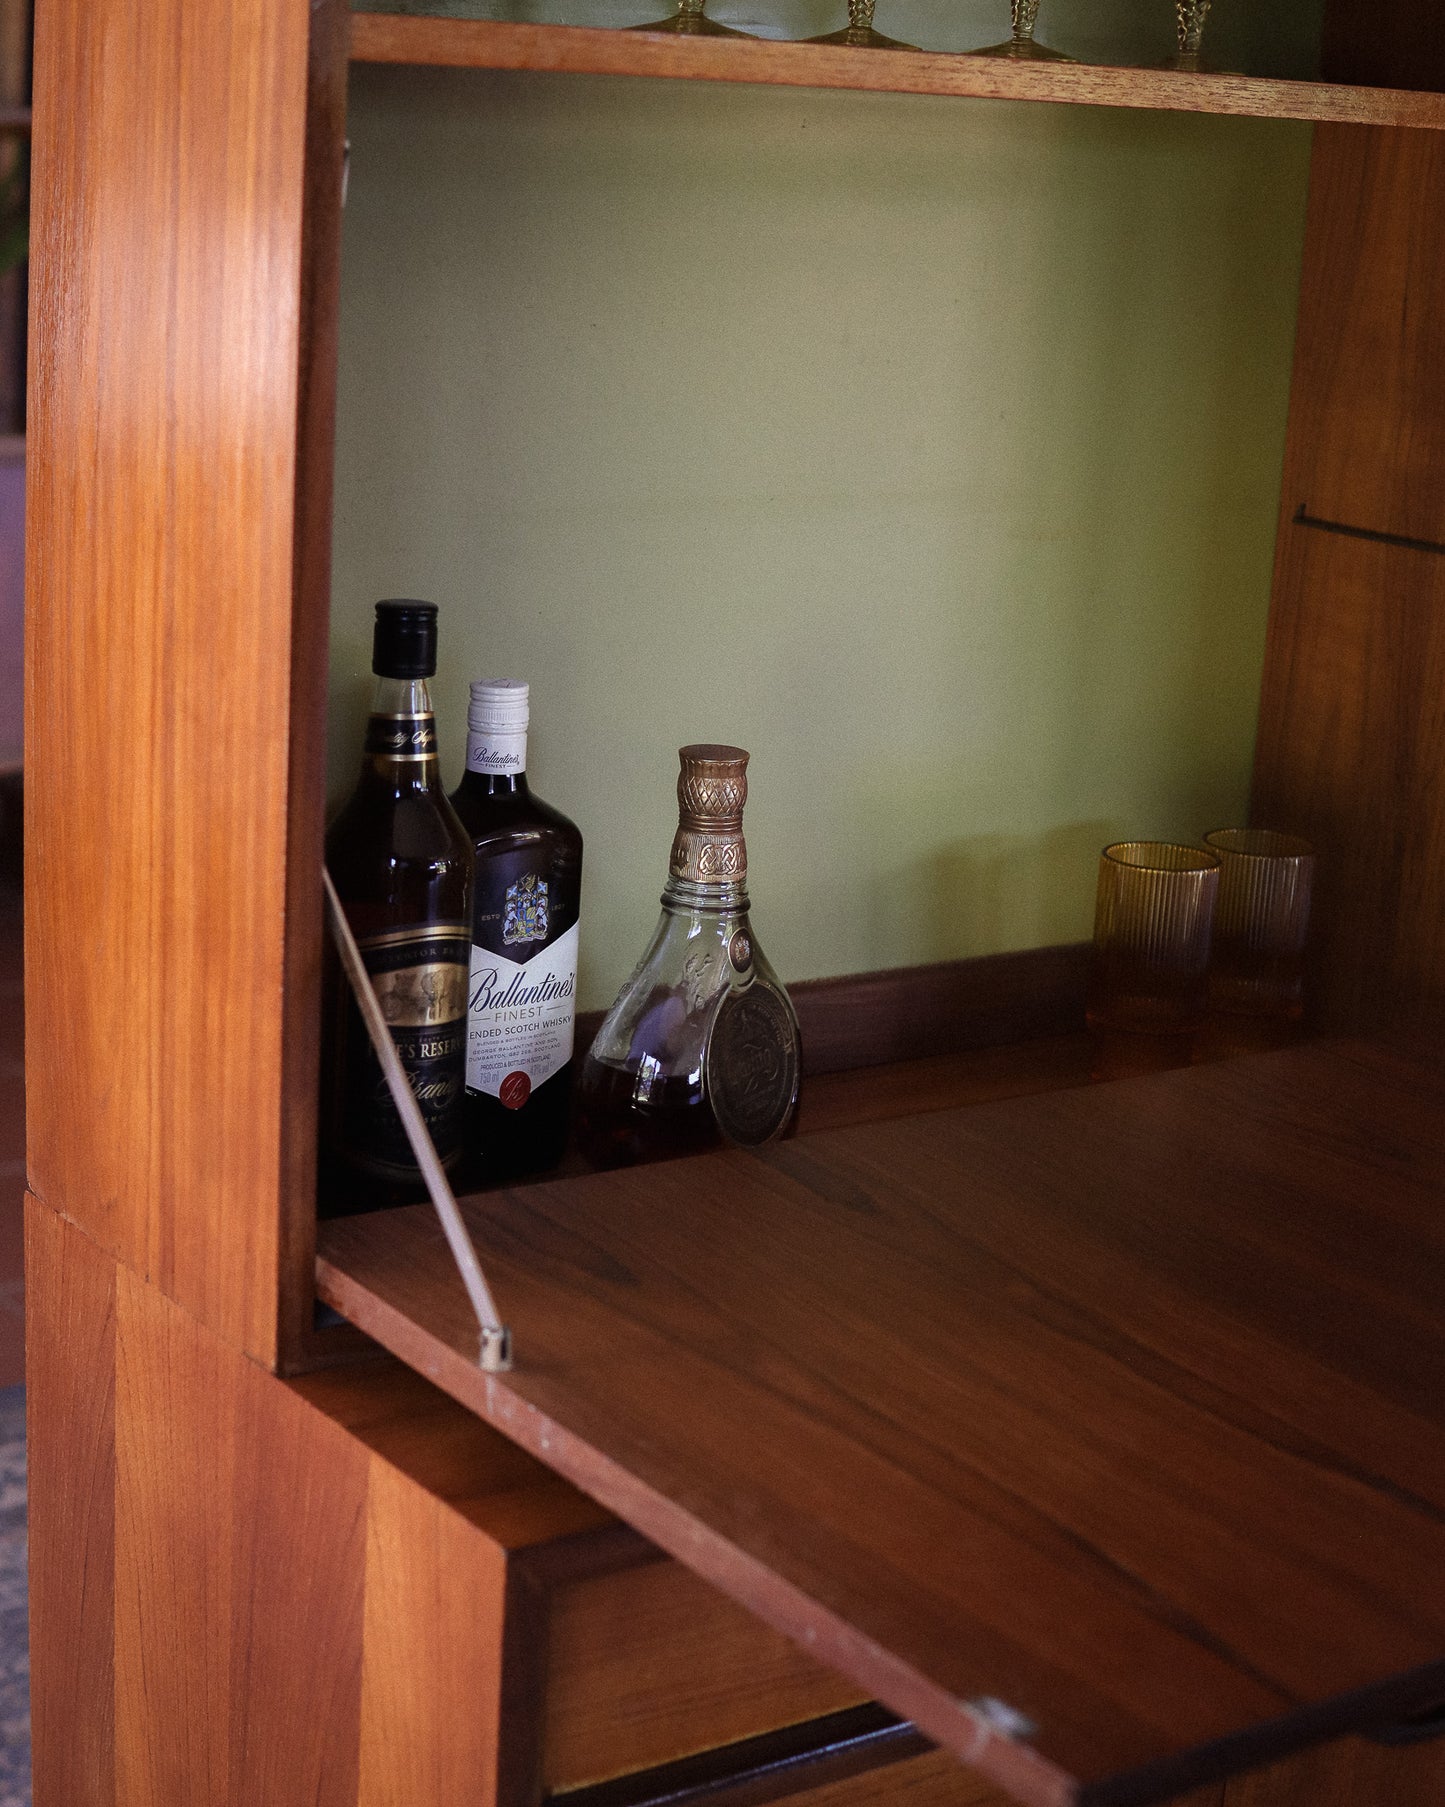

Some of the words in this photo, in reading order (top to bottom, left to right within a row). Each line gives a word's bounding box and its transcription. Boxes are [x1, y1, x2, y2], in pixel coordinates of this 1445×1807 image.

[473, 746, 519, 764] Ballantine's
[469, 967, 575, 1013] Ballantine's
[495, 1006, 544, 1022] FINEST
[467, 1028, 502, 1040] ENDED
[504, 1023, 540, 1035] SCOTCH
[542, 1015, 572, 1029] WHISKY
[472, 1047, 497, 1055] GEORGE
[498, 1042, 533, 1052] BALLANTINE
